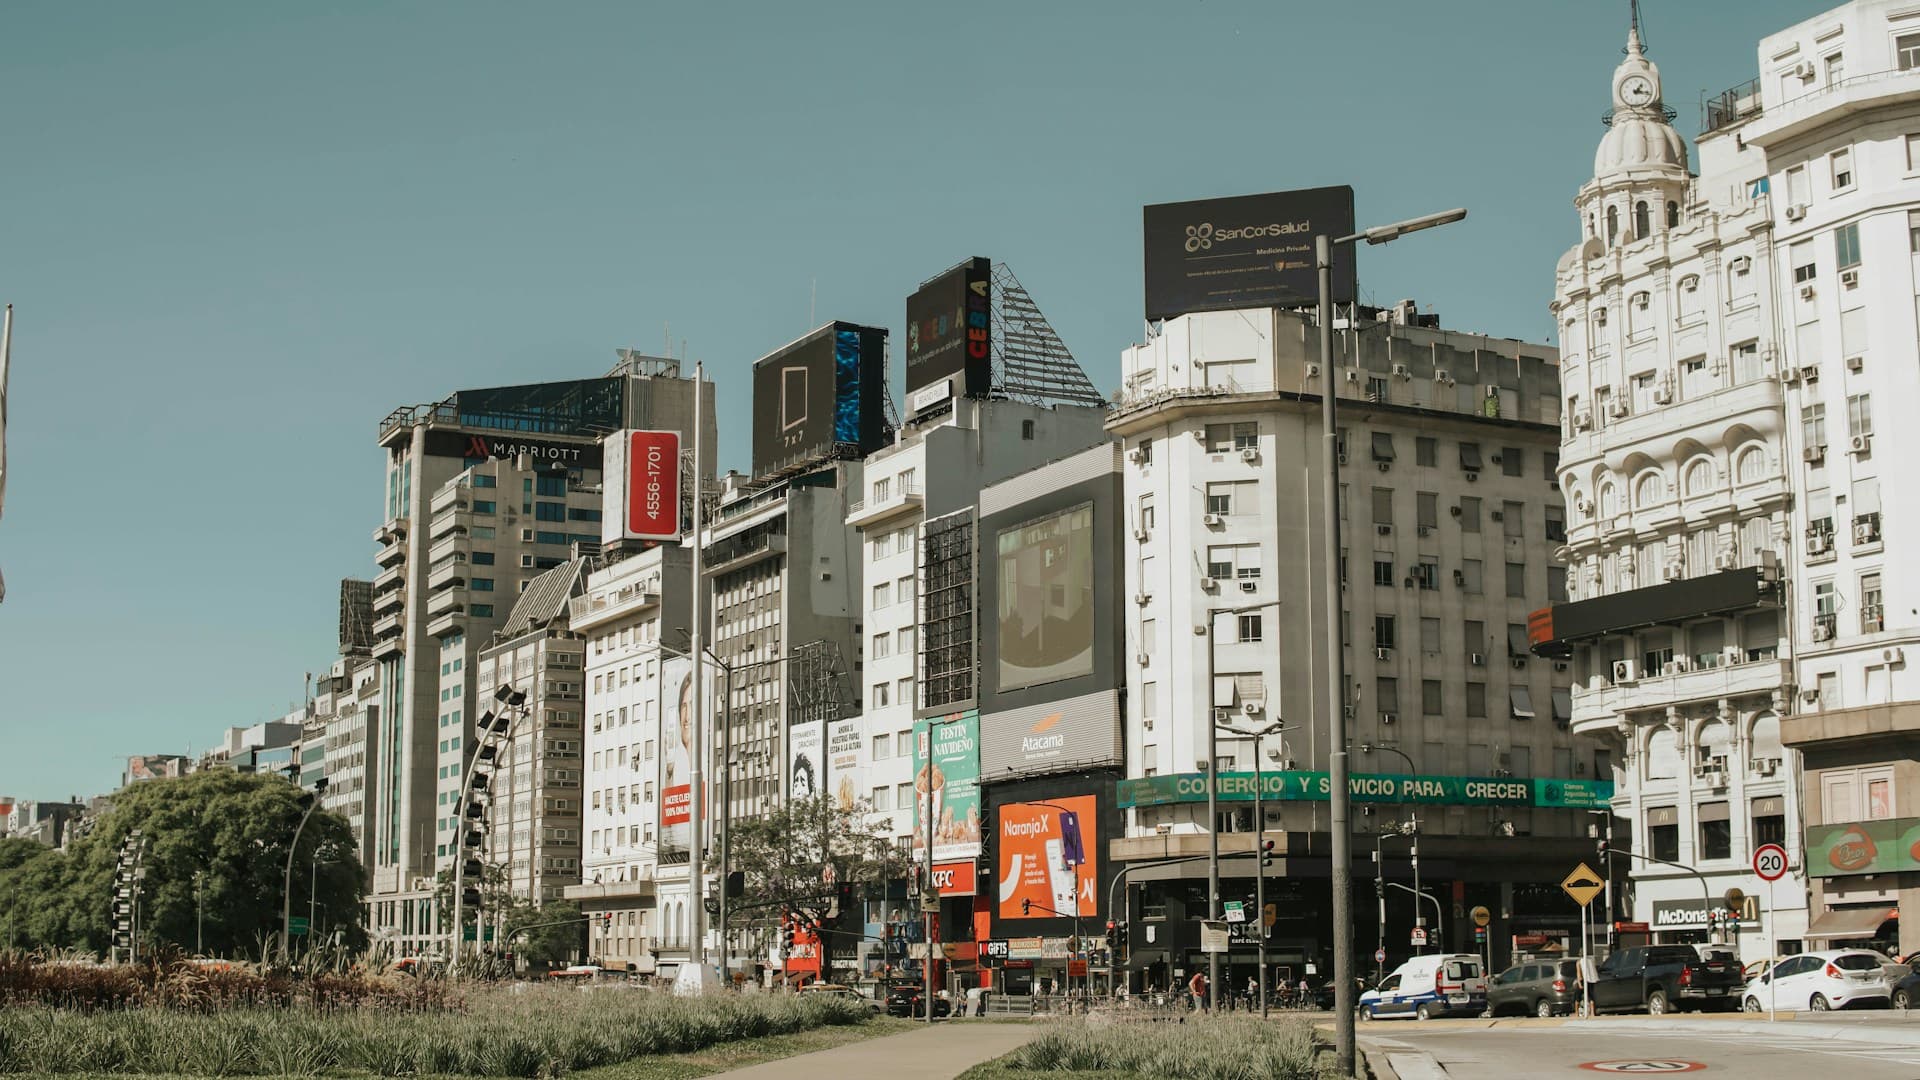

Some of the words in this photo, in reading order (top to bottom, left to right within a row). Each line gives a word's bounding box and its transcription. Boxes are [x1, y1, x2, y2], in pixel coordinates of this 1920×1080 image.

[1215, 220, 1310, 241] SanCorSalud
[493, 442, 580, 460] MARRIOTT
[647, 446, 661, 519] 4556-1701
[934, 736, 974, 757] NAVIDEÑO
[1021, 735, 1064, 752] Atacama
[1299, 777, 1311, 793] Y
[1319, 777, 1395, 796] SVICIO
[1403, 780, 1445, 797] PARA
[1465, 782, 1528, 799] CRECER
[1760, 856, 1781, 871] 20
[932, 870, 954, 888] KFC
